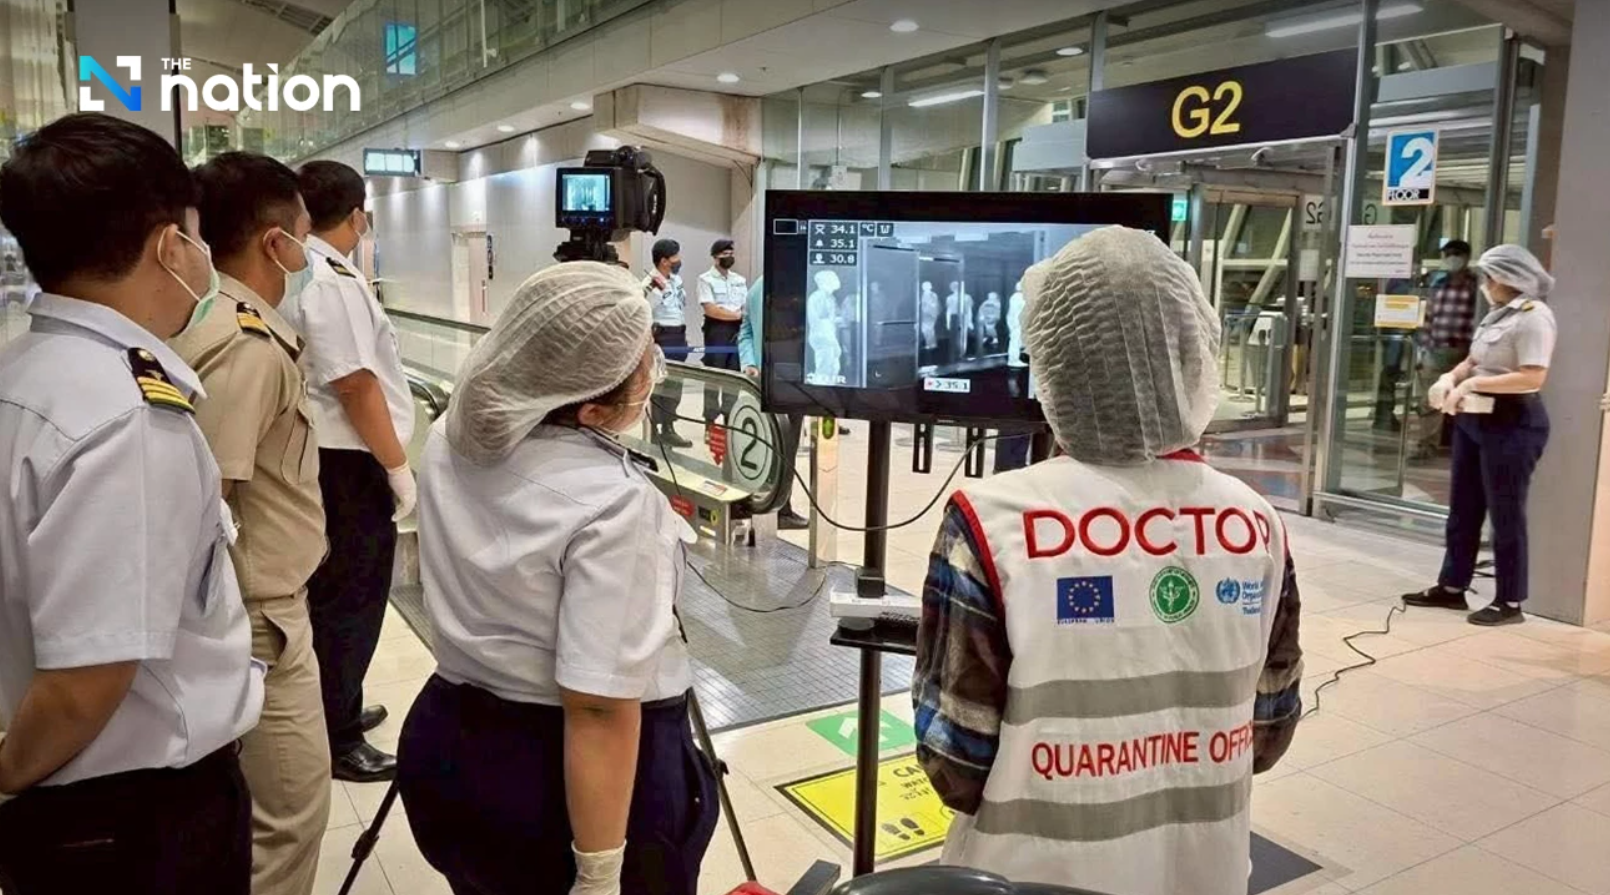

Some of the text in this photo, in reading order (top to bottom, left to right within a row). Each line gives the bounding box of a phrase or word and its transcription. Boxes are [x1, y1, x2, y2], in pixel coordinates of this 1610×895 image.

[1172, 81, 1243, 138] G2
[1399, 136, 1435, 188] 2
[830, 224, 856, 235] 34.1
[830, 238, 855, 249] 35.1
[830, 253, 856, 264] 30.8
[740, 416, 758, 471] 2
[1031, 731, 1200, 781] QUARANTINE
